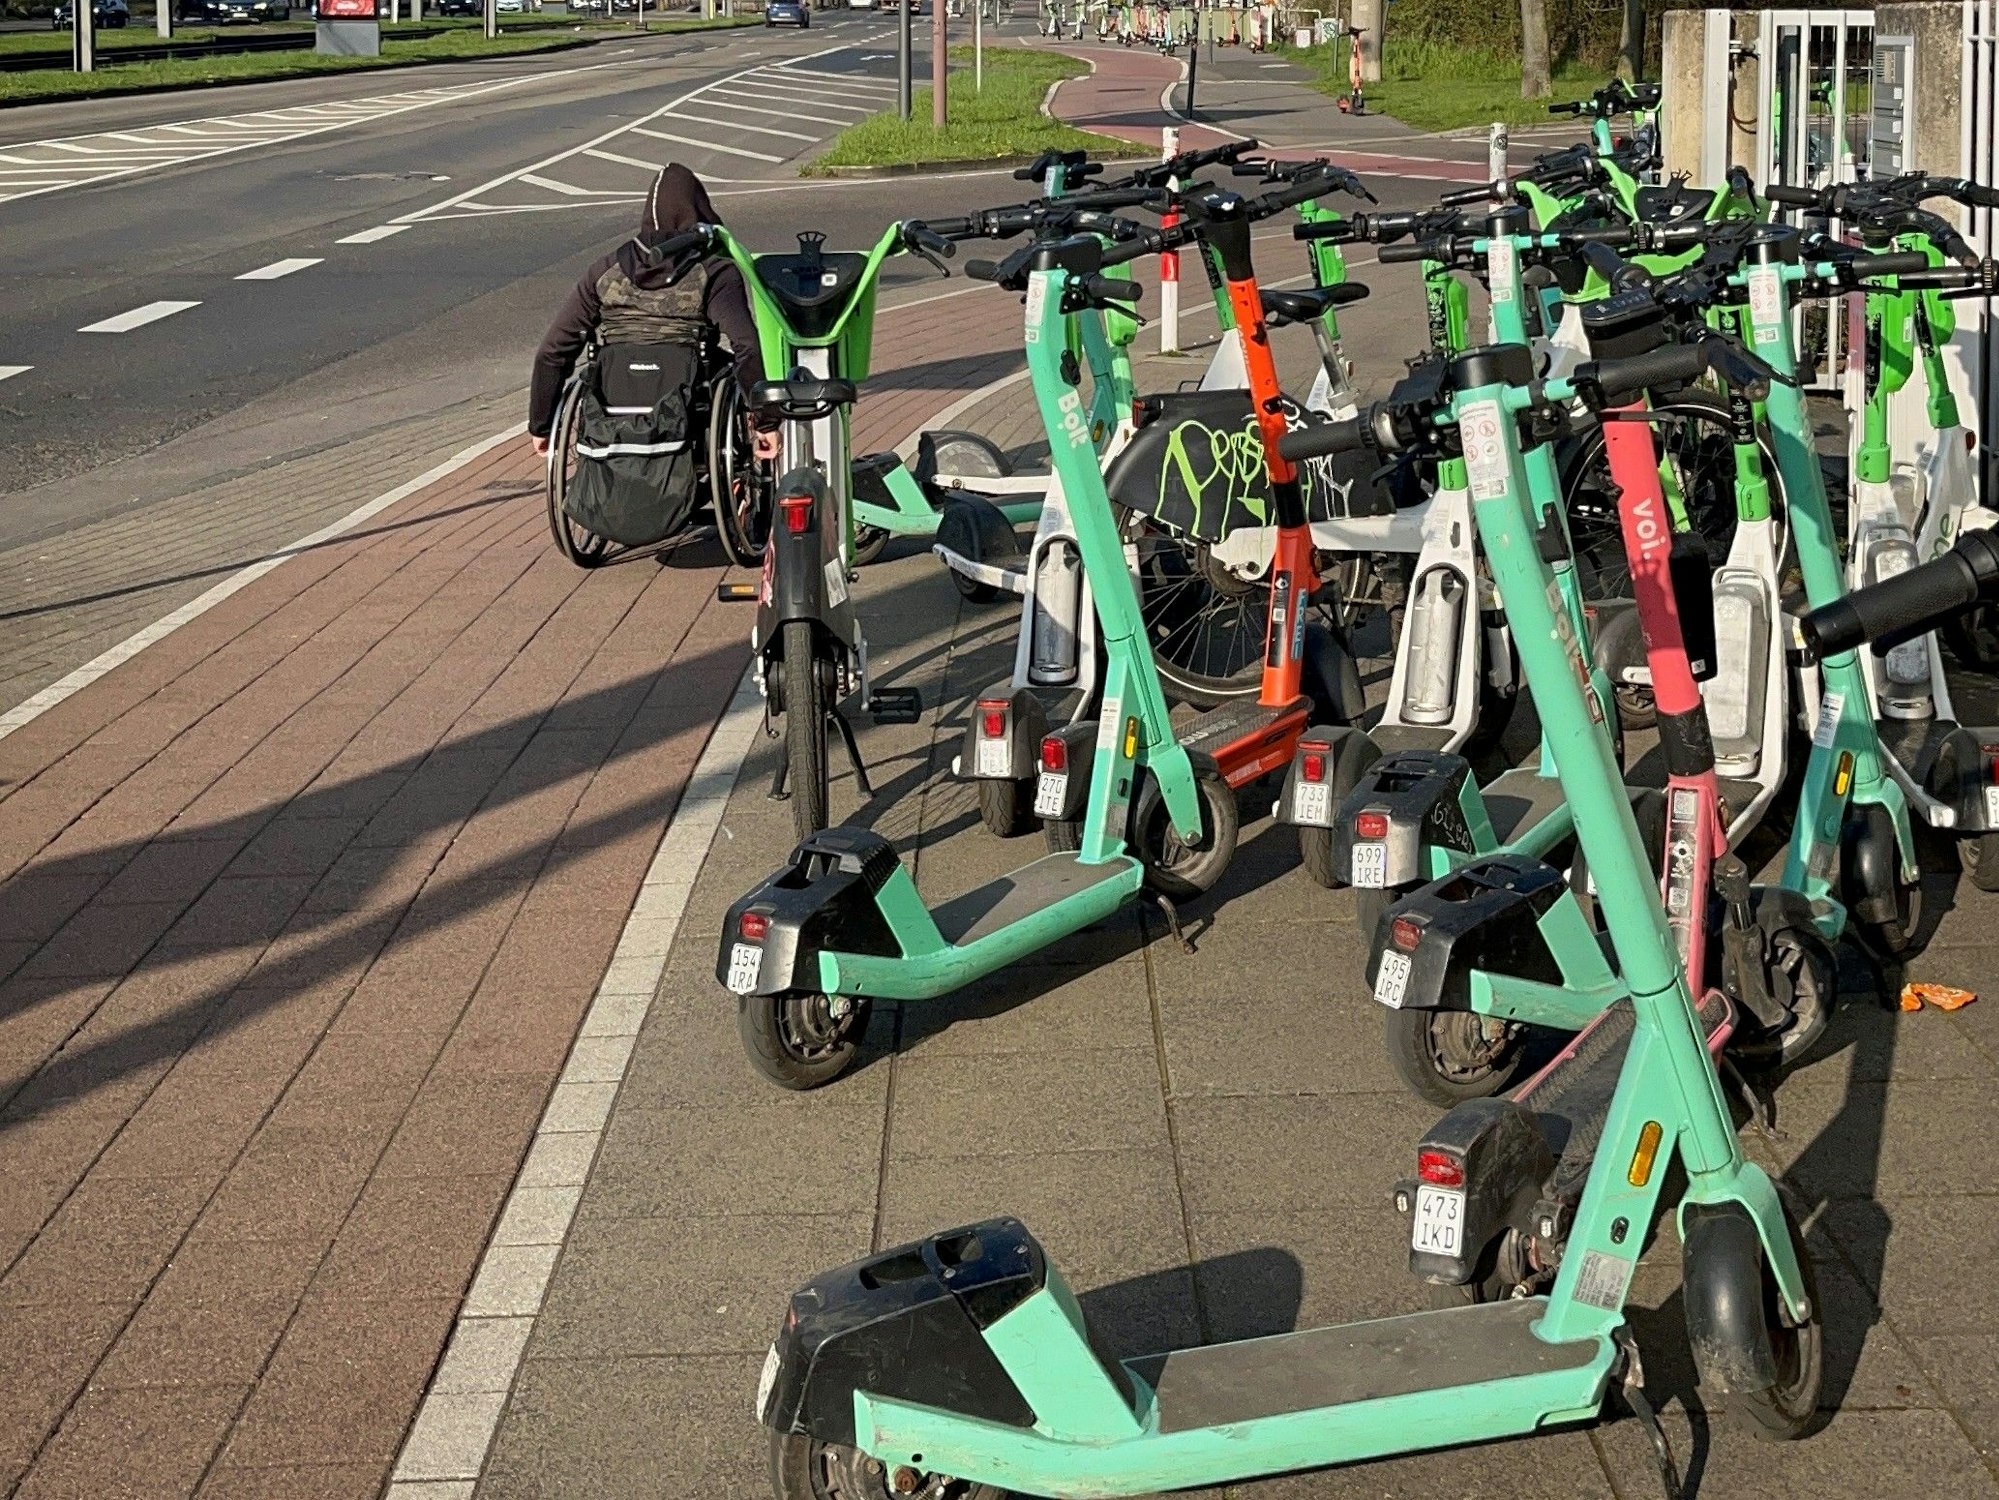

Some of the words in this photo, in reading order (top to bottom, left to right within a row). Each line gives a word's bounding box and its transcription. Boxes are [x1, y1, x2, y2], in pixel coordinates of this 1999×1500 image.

[1057, 389, 1089, 449] Bolt
[1632, 497, 1667, 560] voi.
[1041, 777, 1063, 794] 270
[1300, 785, 1325, 802] 733
[1356, 847, 1382, 865] 699
[1356, 867, 1382, 884] IRE
[734, 948, 757, 967] 154
[1383, 956, 1407, 980] 495
[1422, 1193, 1459, 1221] 473
[1420, 1222, 1455, 1249] IKD
